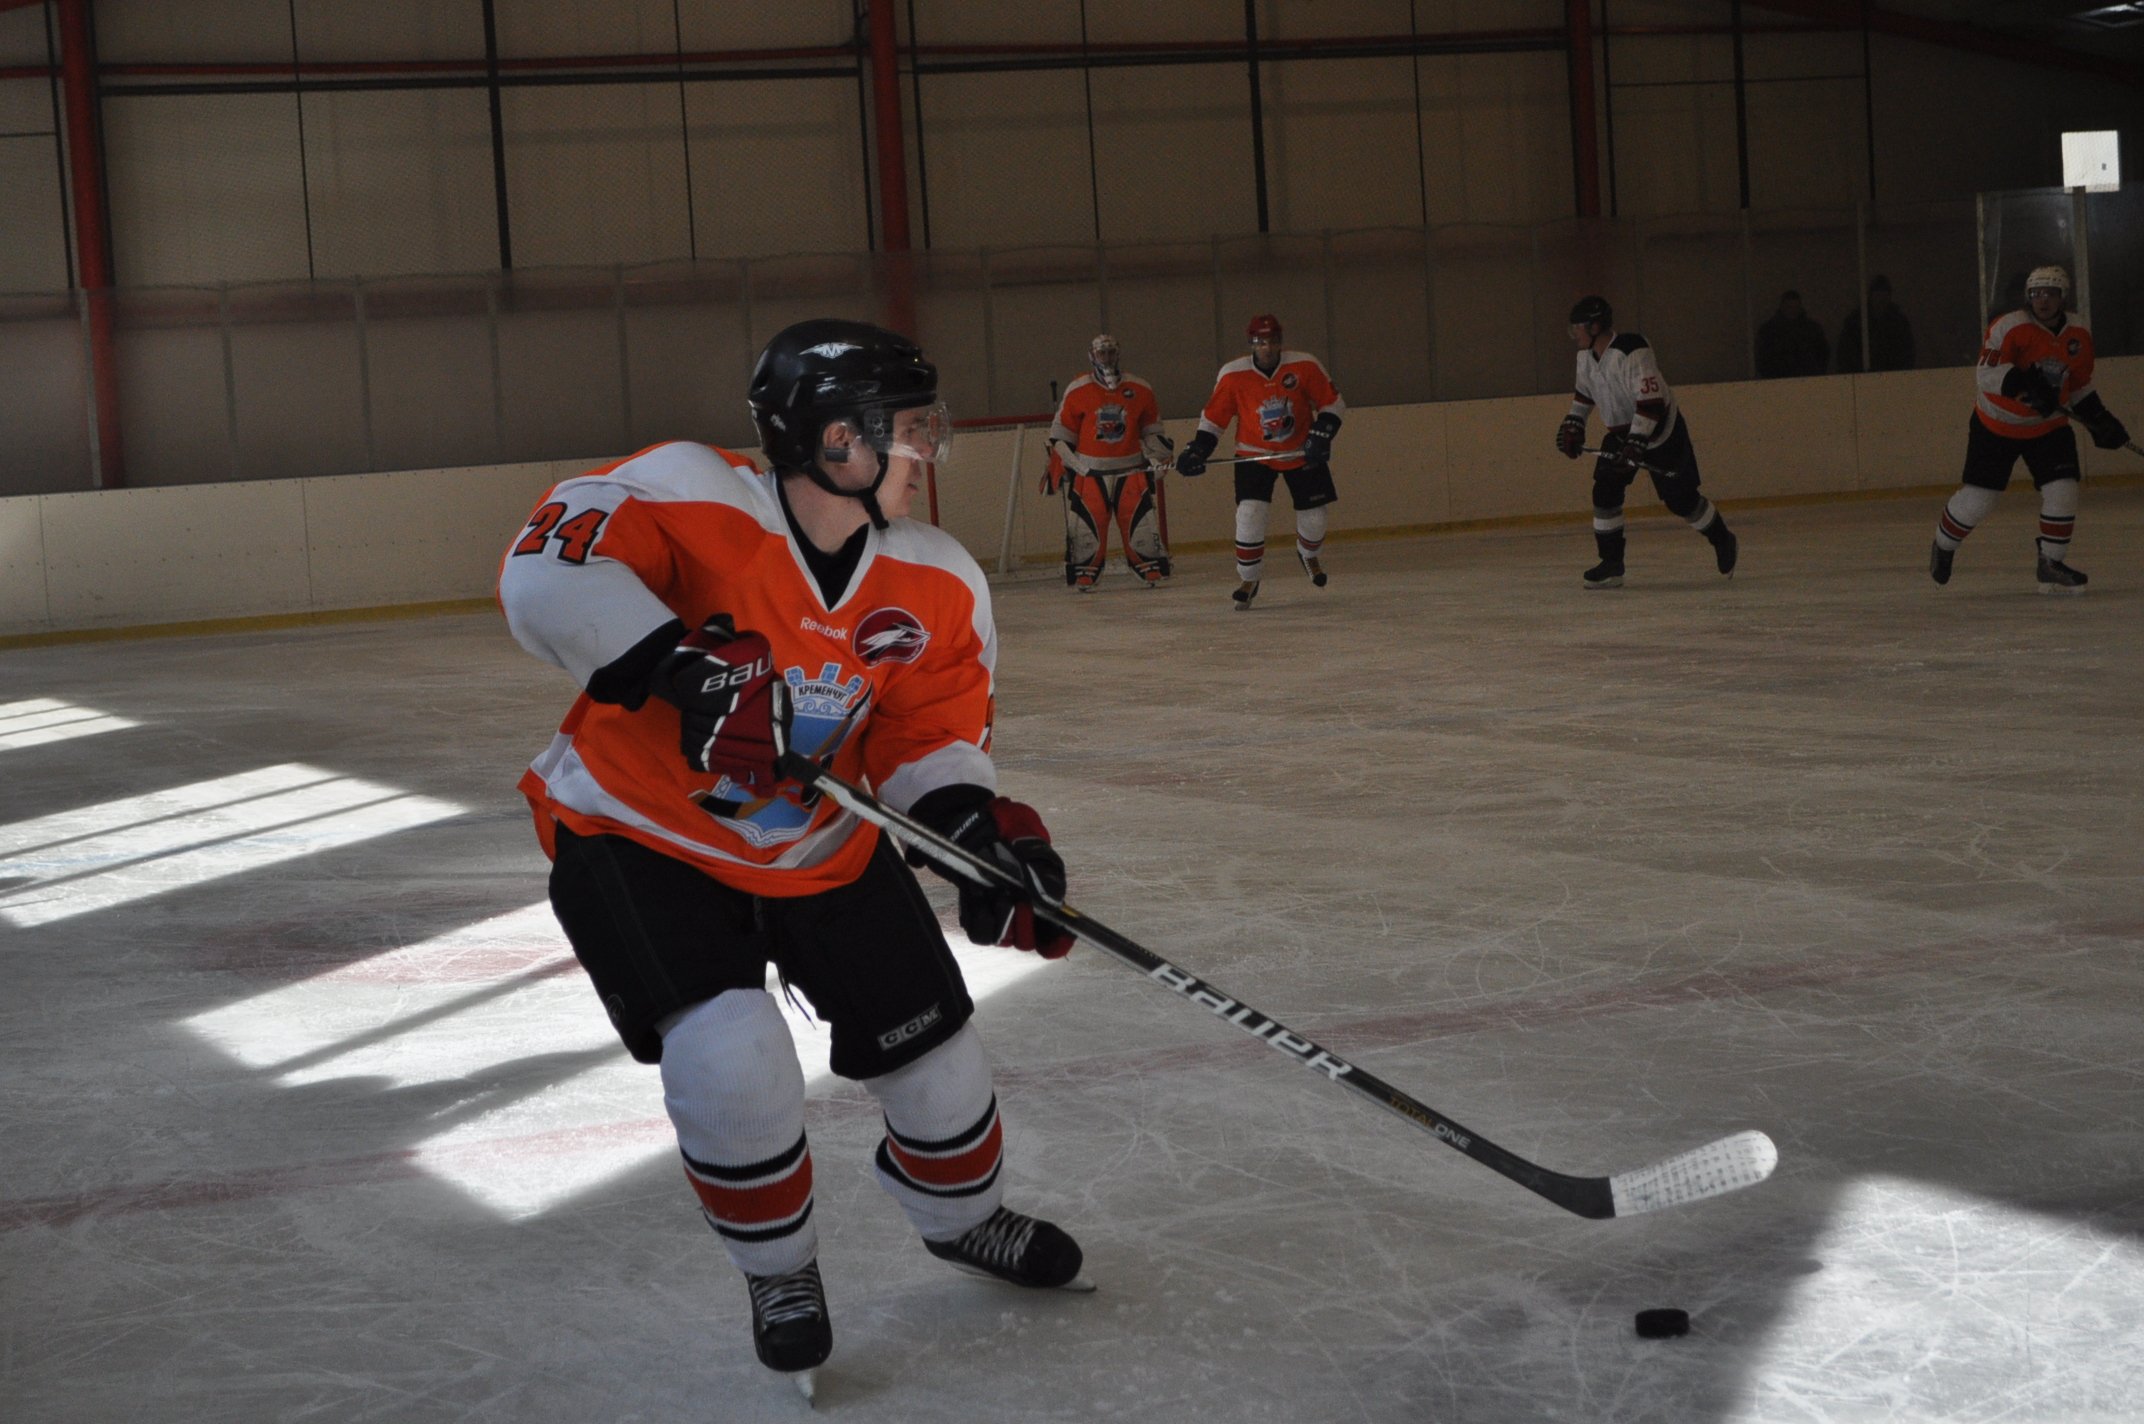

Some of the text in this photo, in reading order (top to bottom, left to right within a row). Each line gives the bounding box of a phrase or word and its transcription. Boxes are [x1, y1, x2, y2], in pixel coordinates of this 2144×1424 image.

[1640, 376, 1660, 394] 35
[512, 501, 609, 565] 24
[800, 616, 849, 641] Reebok
[798, 684, 848, 702] КРЕМЕНЧУГ
[884, 1007, 939, 1044] CCM
[1150, 962, 1353, 1081] BAUER
[1434, 1122, 1471, 1149] ONE
